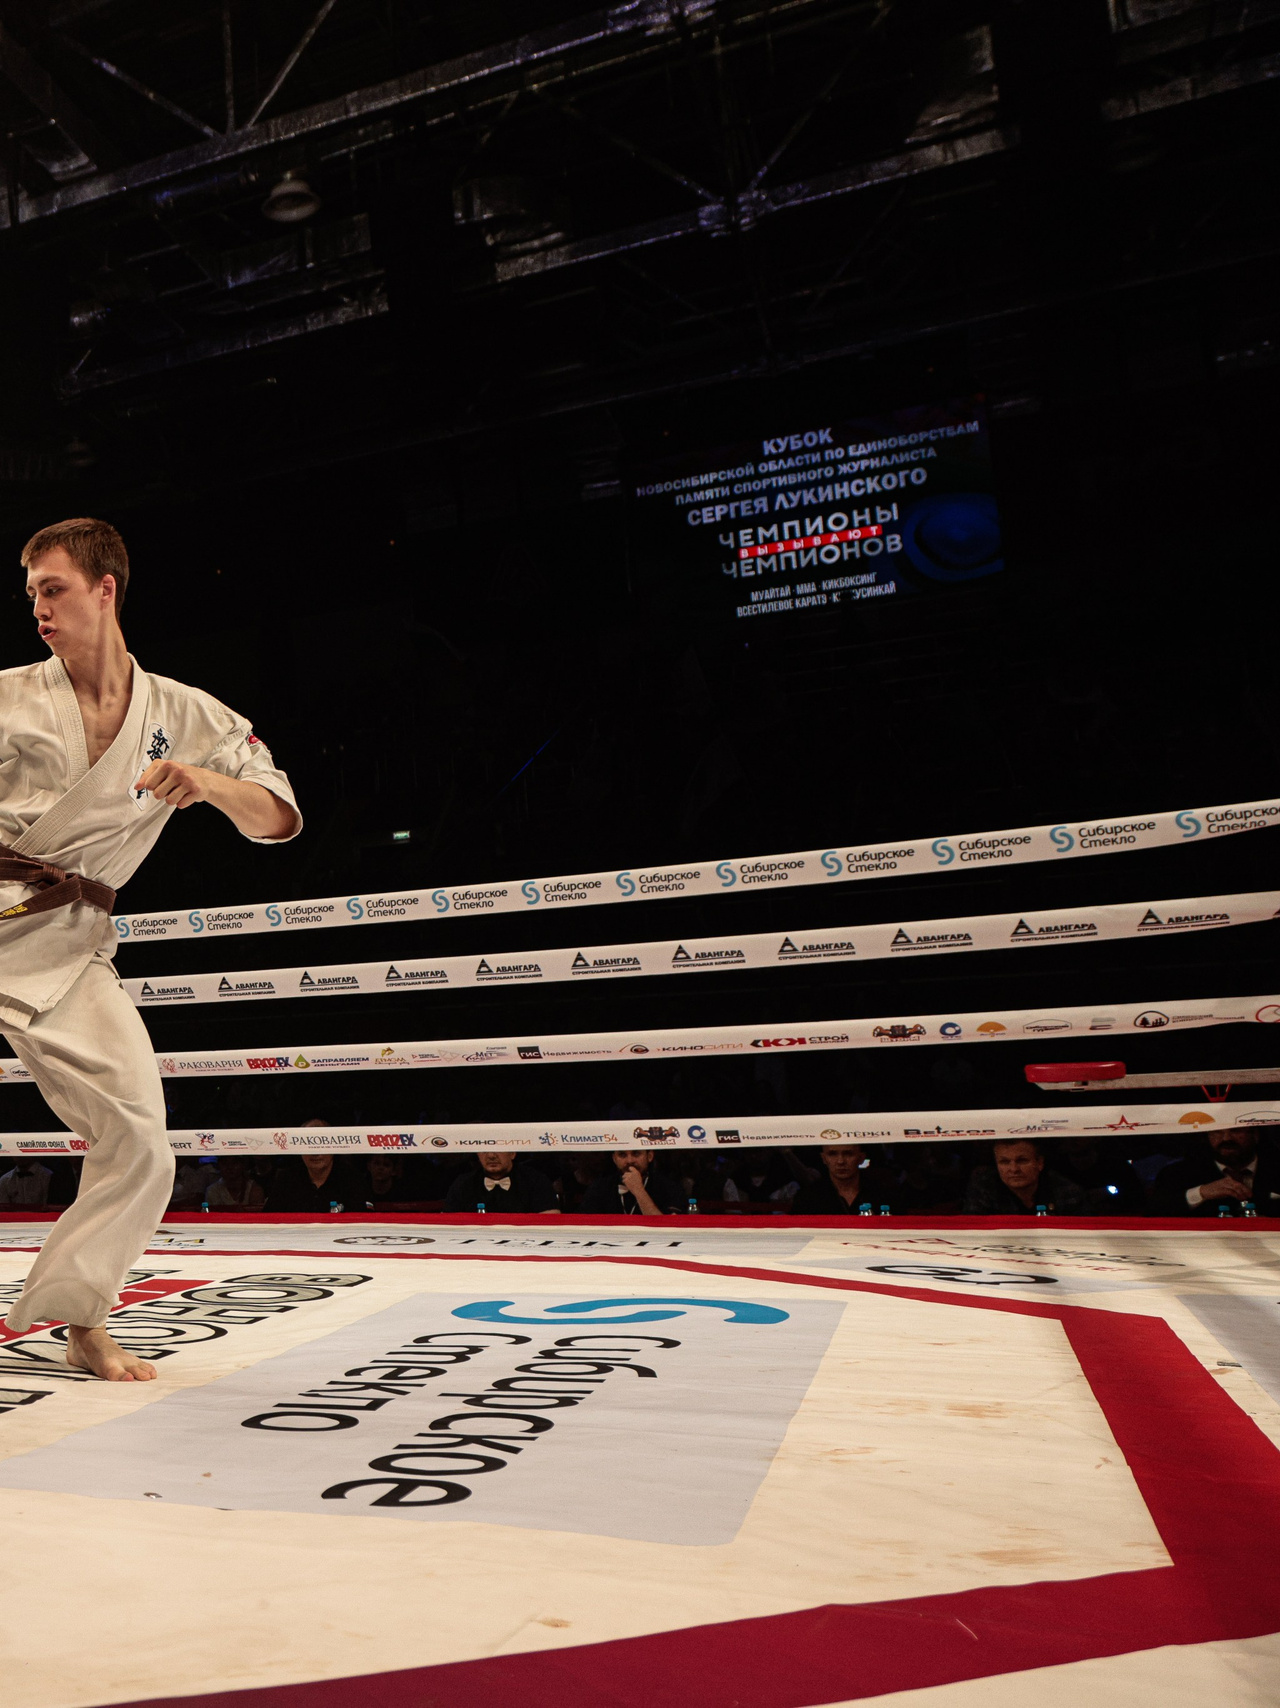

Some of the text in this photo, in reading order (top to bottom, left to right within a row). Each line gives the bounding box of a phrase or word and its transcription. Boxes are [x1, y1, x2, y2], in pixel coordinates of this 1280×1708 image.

[762, 427, 834, 456] КУБОК
[636, 420, 979, 497] НОВОСИБИРСКОЙ ОБЛАСТИ ПО ЕДИНОБОРСТВАМ
[675, 446, 937, 506] ПАМЯТИ СПОРТИВНОГО ЖУРНАЛИСТА
[687, 467, 927, 526] СЕРГЕЯ ЛУКИНСКОГО
[719, 502, 899, 549] ЧЕМПИОНЫ
[740, 526, 879, 559] ВЫЗЫВАЮТ
[722, 534, 903, 579] ЧЕМПИОНОВ
[751, 571, 877, 602] МУАЙТАЙ ММА КИКБОКСИНГ
[736, 600, 795, 618] ВСЕСТИЛЕВОЕ
[795, 593, 827, 609] КАРАТЭ
[1078, 819, 1156, 838] Сибирское
[1207, 819, 1267, 834] Стекло
[958, 834, 1032, 853] Сибирское
[1080, 834, 1136, 849] Стекло
[846, 847, 915, 863] Сибирское
[959, 847, 1013, 862] Стекло
[740, 859, 805, 873] Сибирское
[848, 859, 897, 873] Стекло
[638, 870, 701, 884] Сибирское
[741, 871, 789, 884] Стекло
[543, 879, 602, 893] Сибирское
[640, 881, 685, 894] Стекло
[452, 888, 508, 901] Сибирское
[544, 891, 587, 903] Стекло
[366, 896, 419, 909] Сибирское
[453, 899, 494, 911] Стекло
[284, 904, 335, 916] Сибирское
[367, 907, 406, 919] Стекло
[131, 917, 178, 928] Сибирское
[206, 911, 254, 922] Сибирское
[285, 914, 322, 926] Стекло
[1167, 913, 1229, 924] АВАНГАРД
[133, 926, 166, 936] Стекло
[207, 921, 243, 932] Стекло
[1038, 923, 1097, 934] АВАНГАРД
[916, 933, 972, 943] АВАНГАРД
[802, 942, 854, 951] АВАНГАРД
[695, 950, 744, 959] АВАНГАРД
[592, 957, 640, 966] АВАНГАРД
[404, 969, 447, 978] АВАНГАРД
[496, 964, 541, 973] АВАНГАРД
[235, 981, 274, 990] АВАНГАРД
[317, 976, 359, 985] АВАНГАРД
[157, 987, 194, 995] АВАНГАРД
[809, 1033, 849, 1041] СТРОЙ
[662, 1043, 743, 1051] КИНОСИТИ
[180, 1060, 243, 1070] РАКОВАРНЯ
[246, 1057, 293, 1069] BROZEX
[16, 1140, 66, 1149] САМОЙЛОВ ФОНД
[292, 1135, 361, 1145] РАКОВАРНЯ
[366, 1134, 418, 1147] BROZEX
[561, 1134, 618, 1143] Климат54
[240, 1331, 532, 1432] Стекло
[320, 1334, 680, 1507] Сибирское
